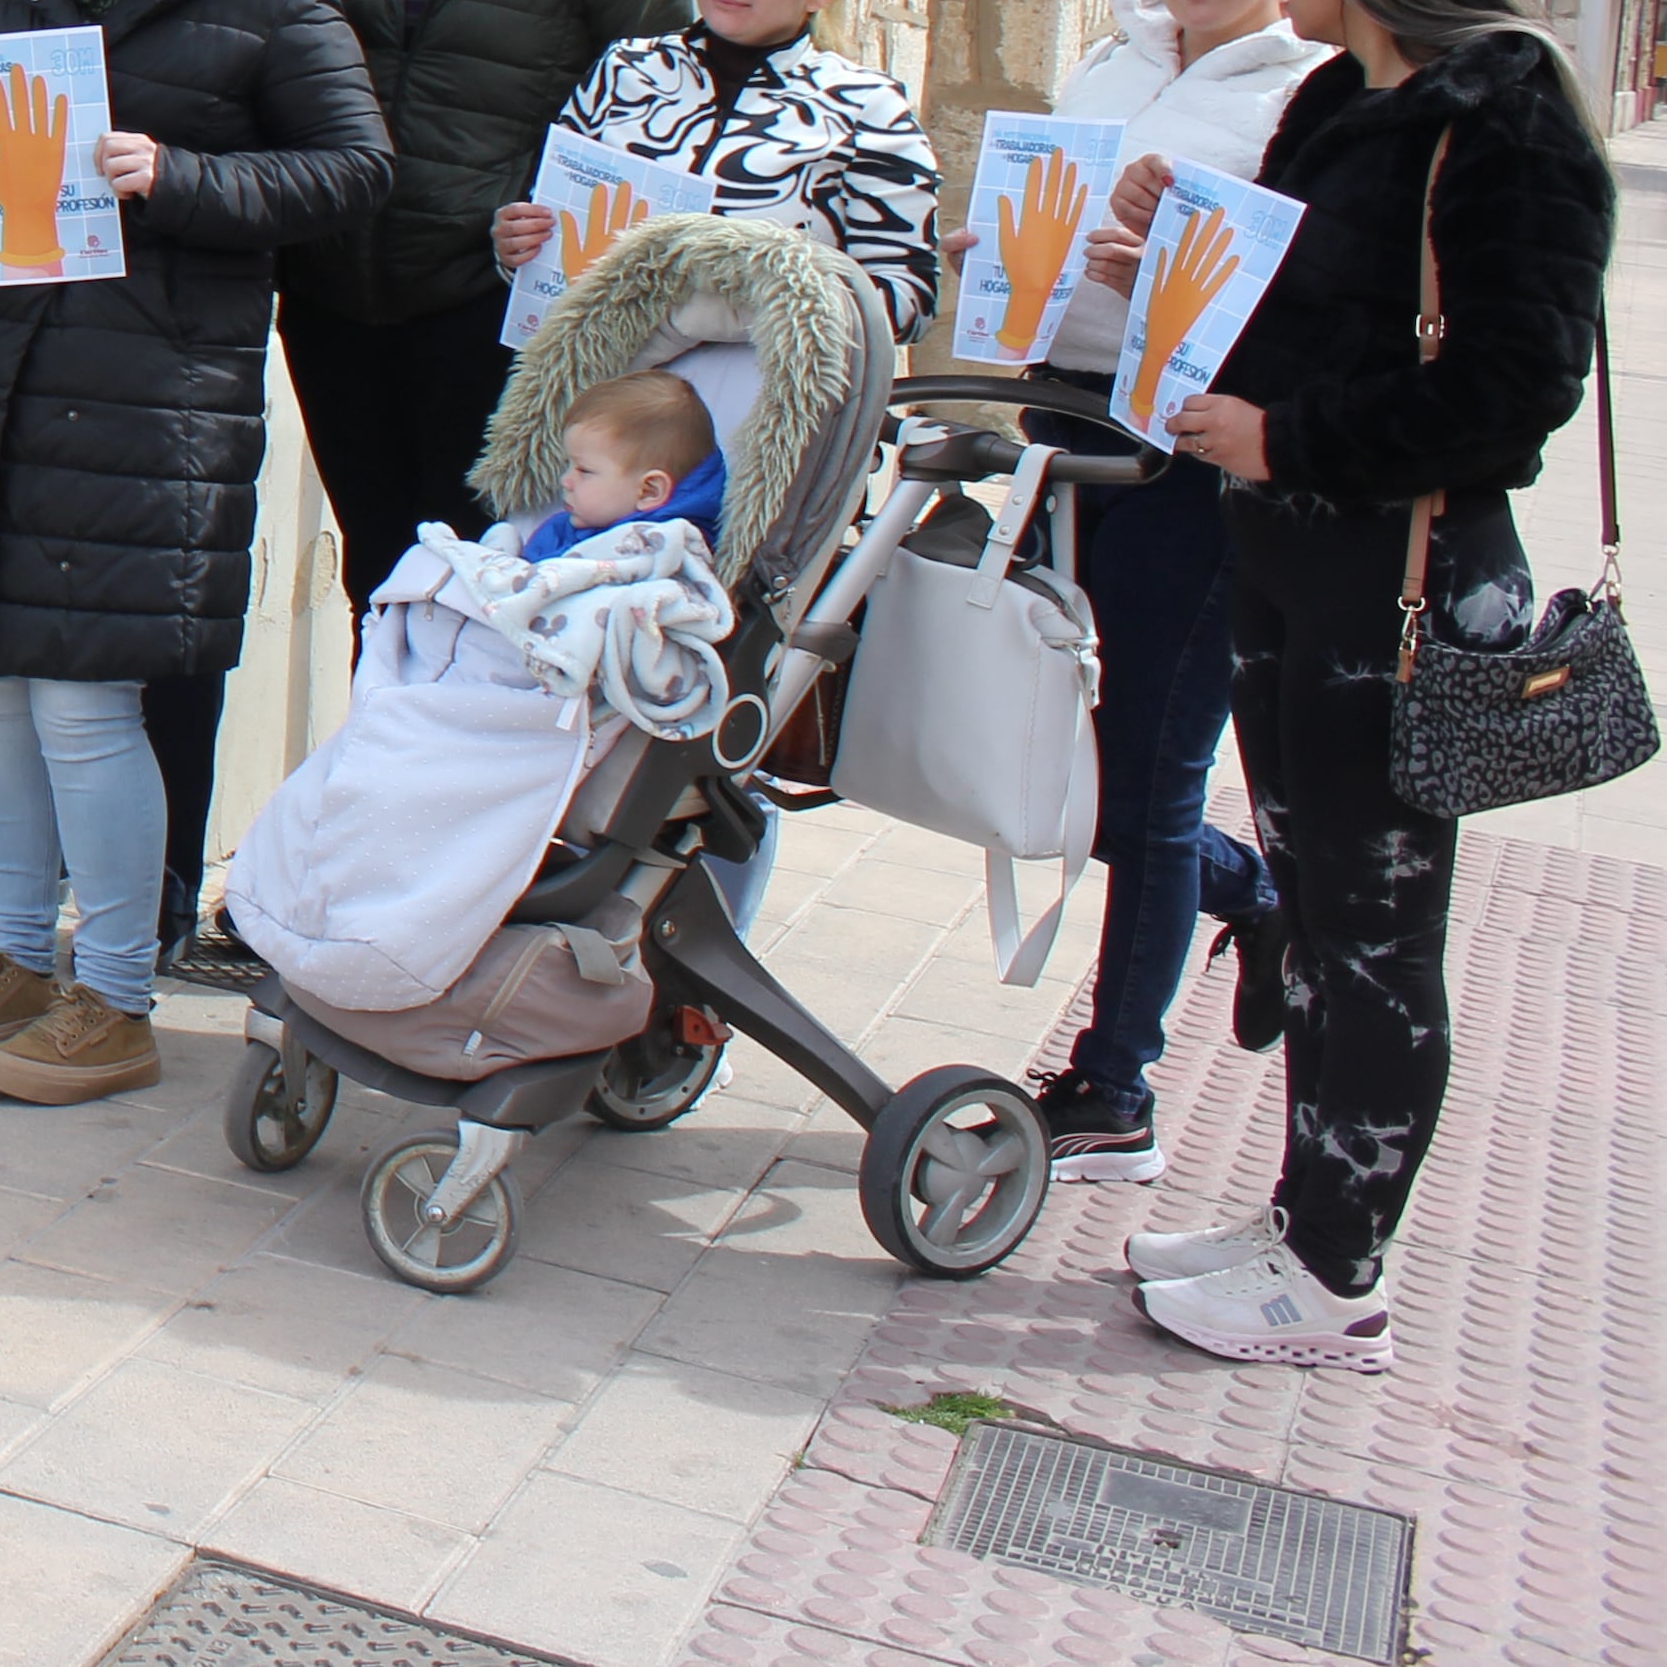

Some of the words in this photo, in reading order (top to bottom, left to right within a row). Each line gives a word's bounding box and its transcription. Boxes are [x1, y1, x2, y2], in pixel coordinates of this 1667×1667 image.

[50, 46, 97, 77] 30M
[995, 139, 1057, 155] TRABAJADORAS
[557, 154, 623, 184] TRABAJADORAS
[59, 184, 76, 198] SU
[55, 192, 116, 214] PROFESIÓN
[551, 270, 565, 285] TU
[993, 265, 1005, 279] TU
[979, 279, 1012, 295] HOGAR
[1176, 341, 1189, 356] SU
[1167, 356, 1212, 386] PROFESIÓN
